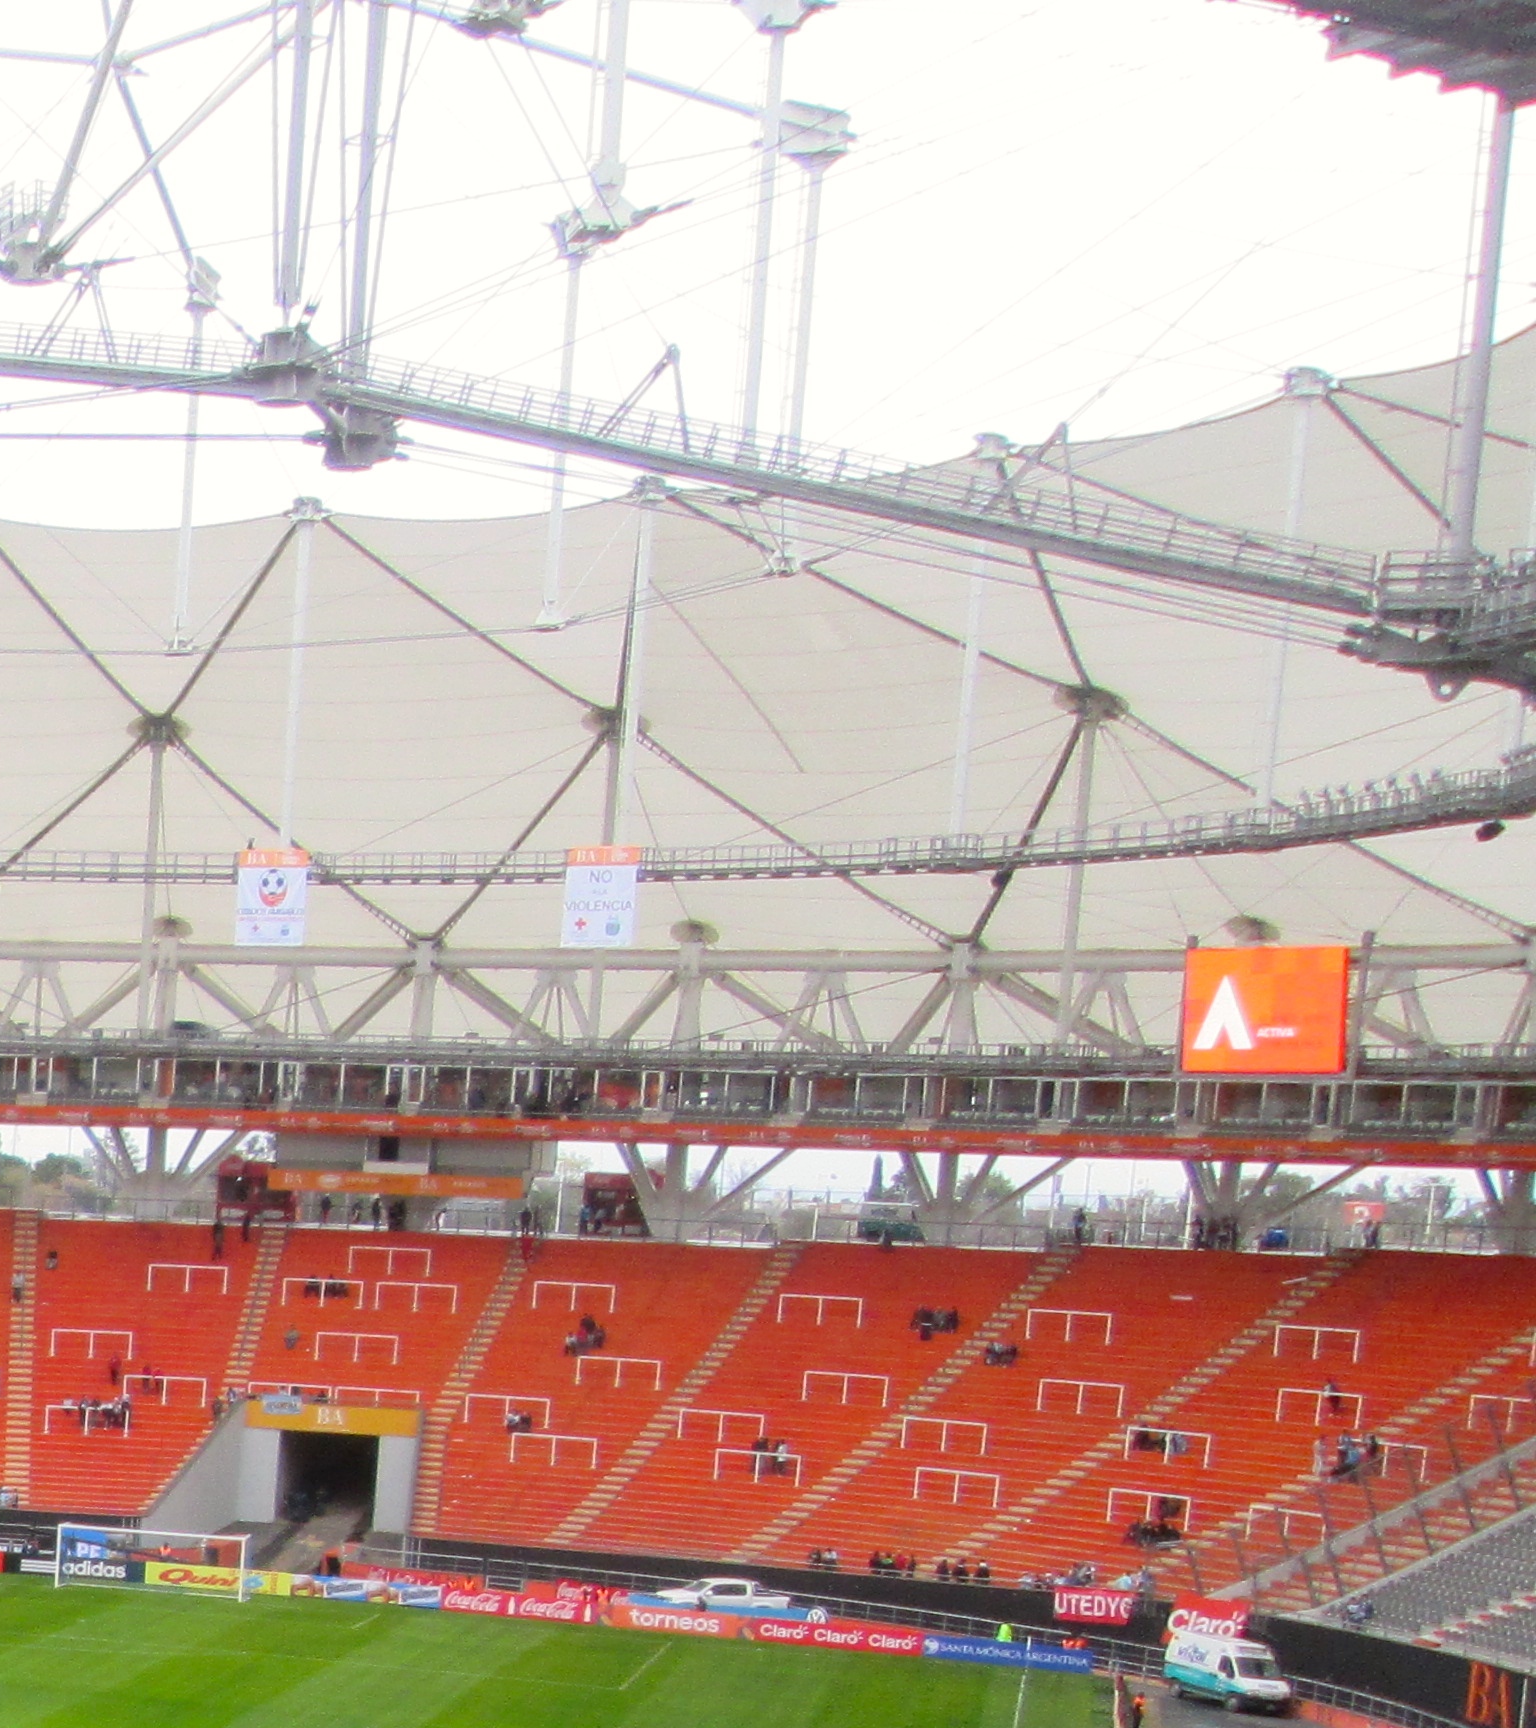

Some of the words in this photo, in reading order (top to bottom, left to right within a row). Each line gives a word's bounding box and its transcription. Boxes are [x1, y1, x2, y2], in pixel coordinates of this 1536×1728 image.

[589, 870, 613, 883] NO
[566, 900, 632, 911] VIOLENCIA
[1255, 1025, 1297, 1039] ACTIVA
[317, 1407, 343, 1426] BA
[62, 1559, 126, 1578] adidas
[158, 1567, 239, 1588] Quini
[444, 1590, 501, 1613] Coca-Cola
[519, 1597, 578, 1620] Coca-Cola
[630, 1606, 720, 1633] torneos
[1167, 1608, 1236, 1638] Claro
[760, 1623, 804, 1640] Claro
[814, 1628, 859, 1645] Claro
[868, 1633, 913, 1650] Claro
[940, 1644, 973, 1655] SANTA
[976, 1647, 1022, 1660] MÓNICA
[1025, 1652, 1089, 1667] ARGENTINA
